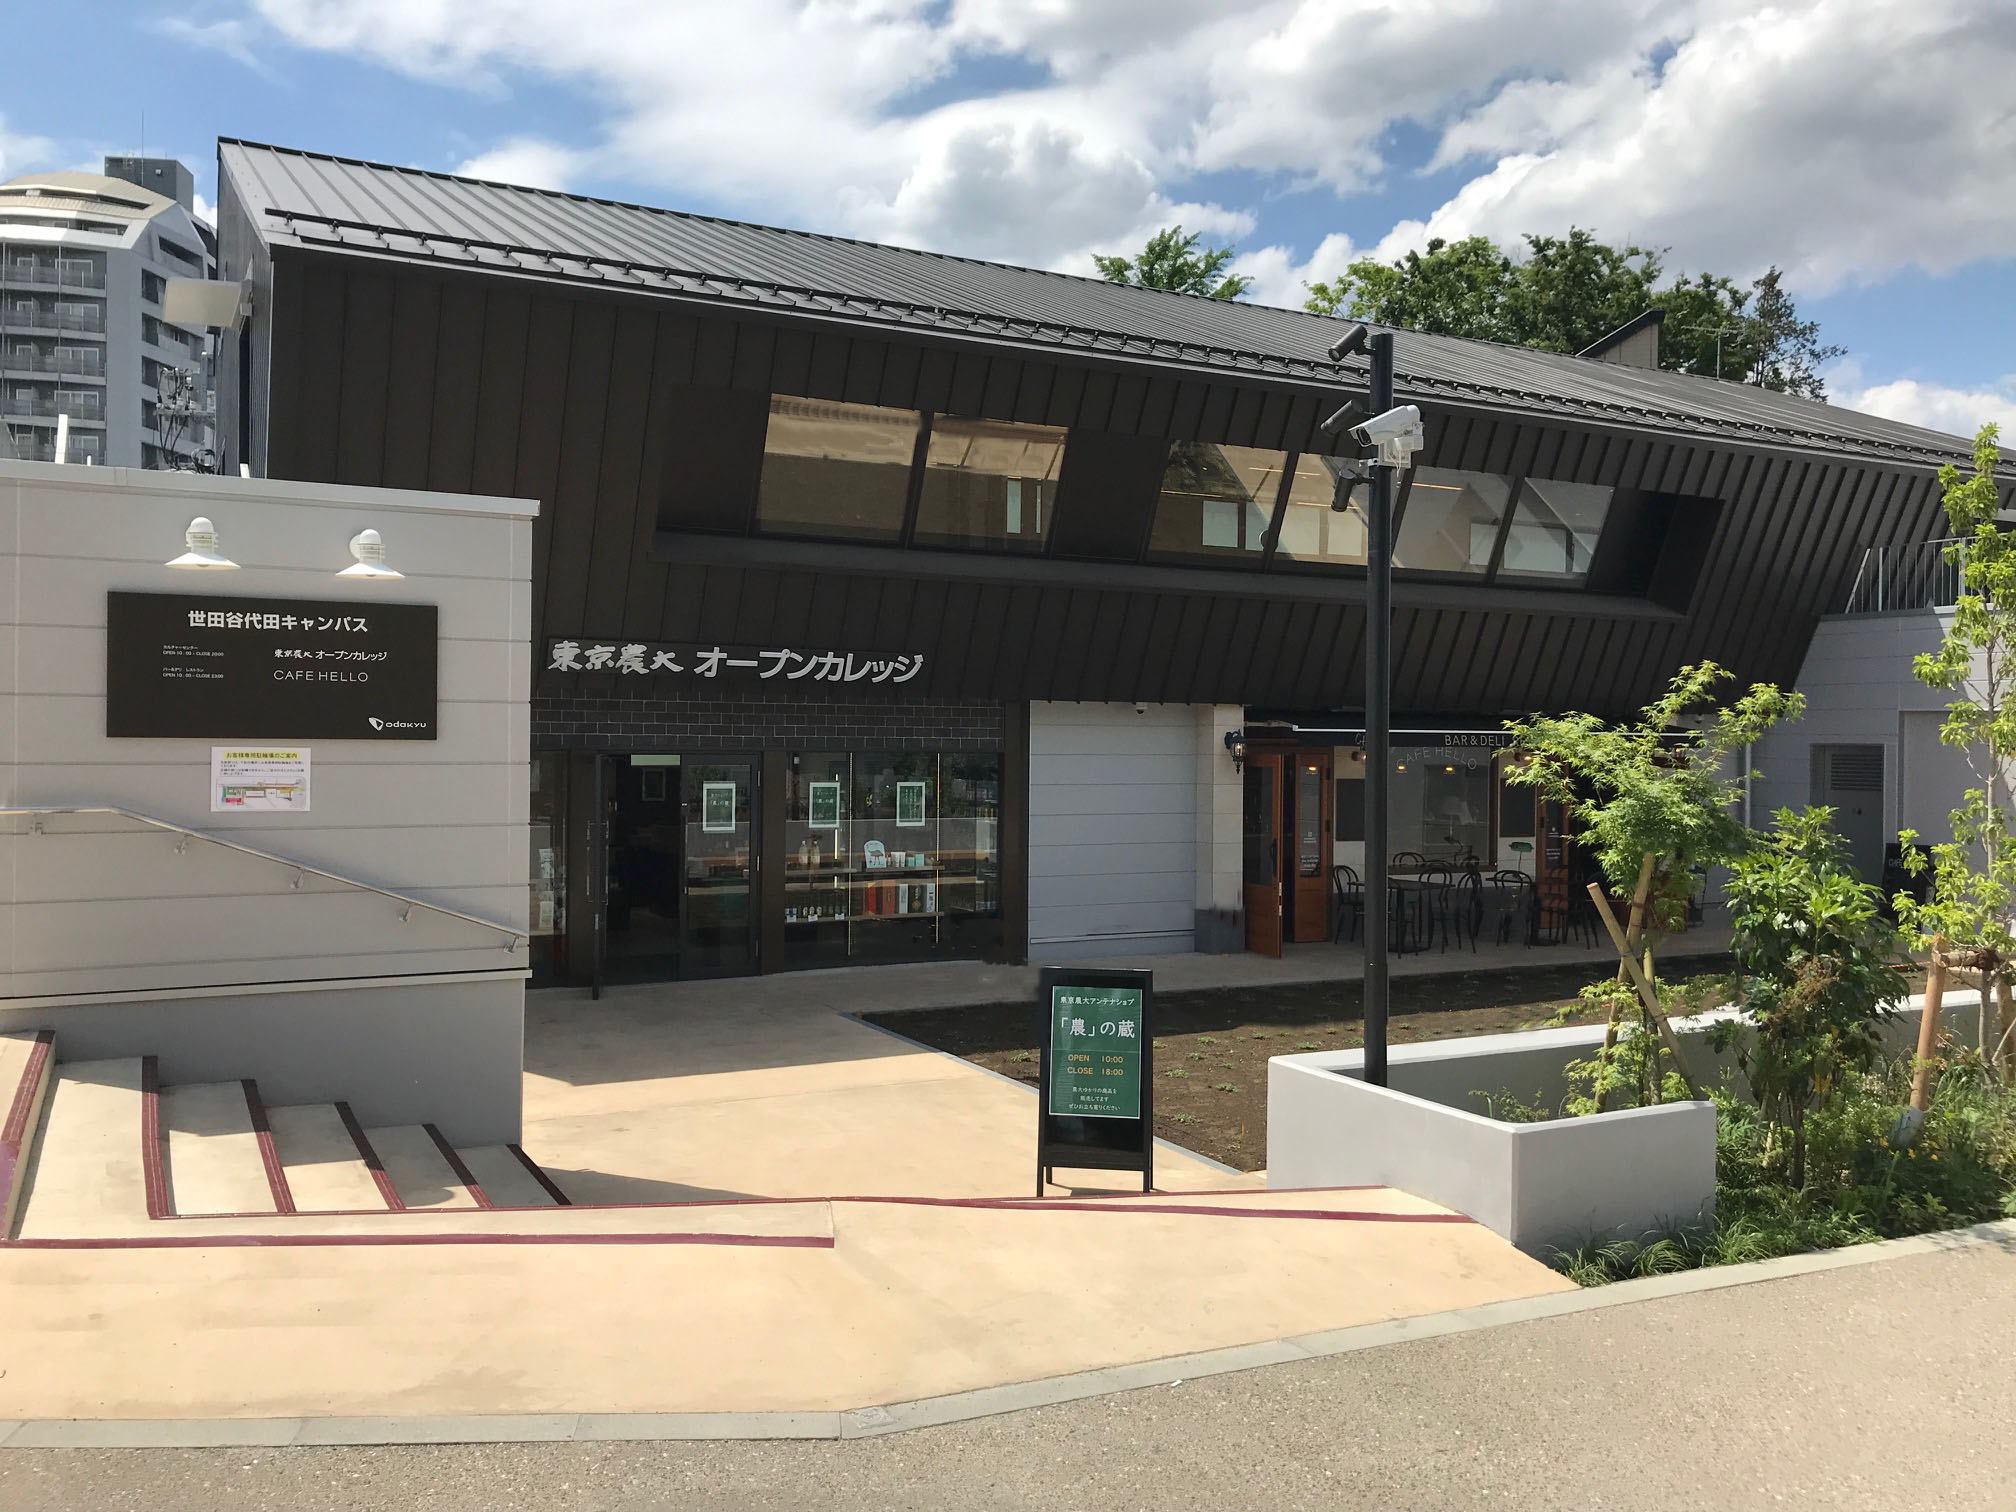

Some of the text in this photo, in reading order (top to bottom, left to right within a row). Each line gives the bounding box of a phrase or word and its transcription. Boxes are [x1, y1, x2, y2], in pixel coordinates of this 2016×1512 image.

[188, 610, 368, 632] 世田谷代田キャンパス
[315, 650, 388, 661] オープンカレッジ
[548, 641, 924, 683] 東京農大 オープンカレッジ
[273, 670, 369, 683] CAFE HELLO
[385, 720, 427, 728] odakyu
[1396, 746, 1477, 770] CAFE HELLO
[1061, 1017, 1135, 1039] 「農」の蔵
[1067, 1054, 1124, 1063] OPEN 10:00
[1067, 1066, 1124, 1076] CLOSE 18:00
